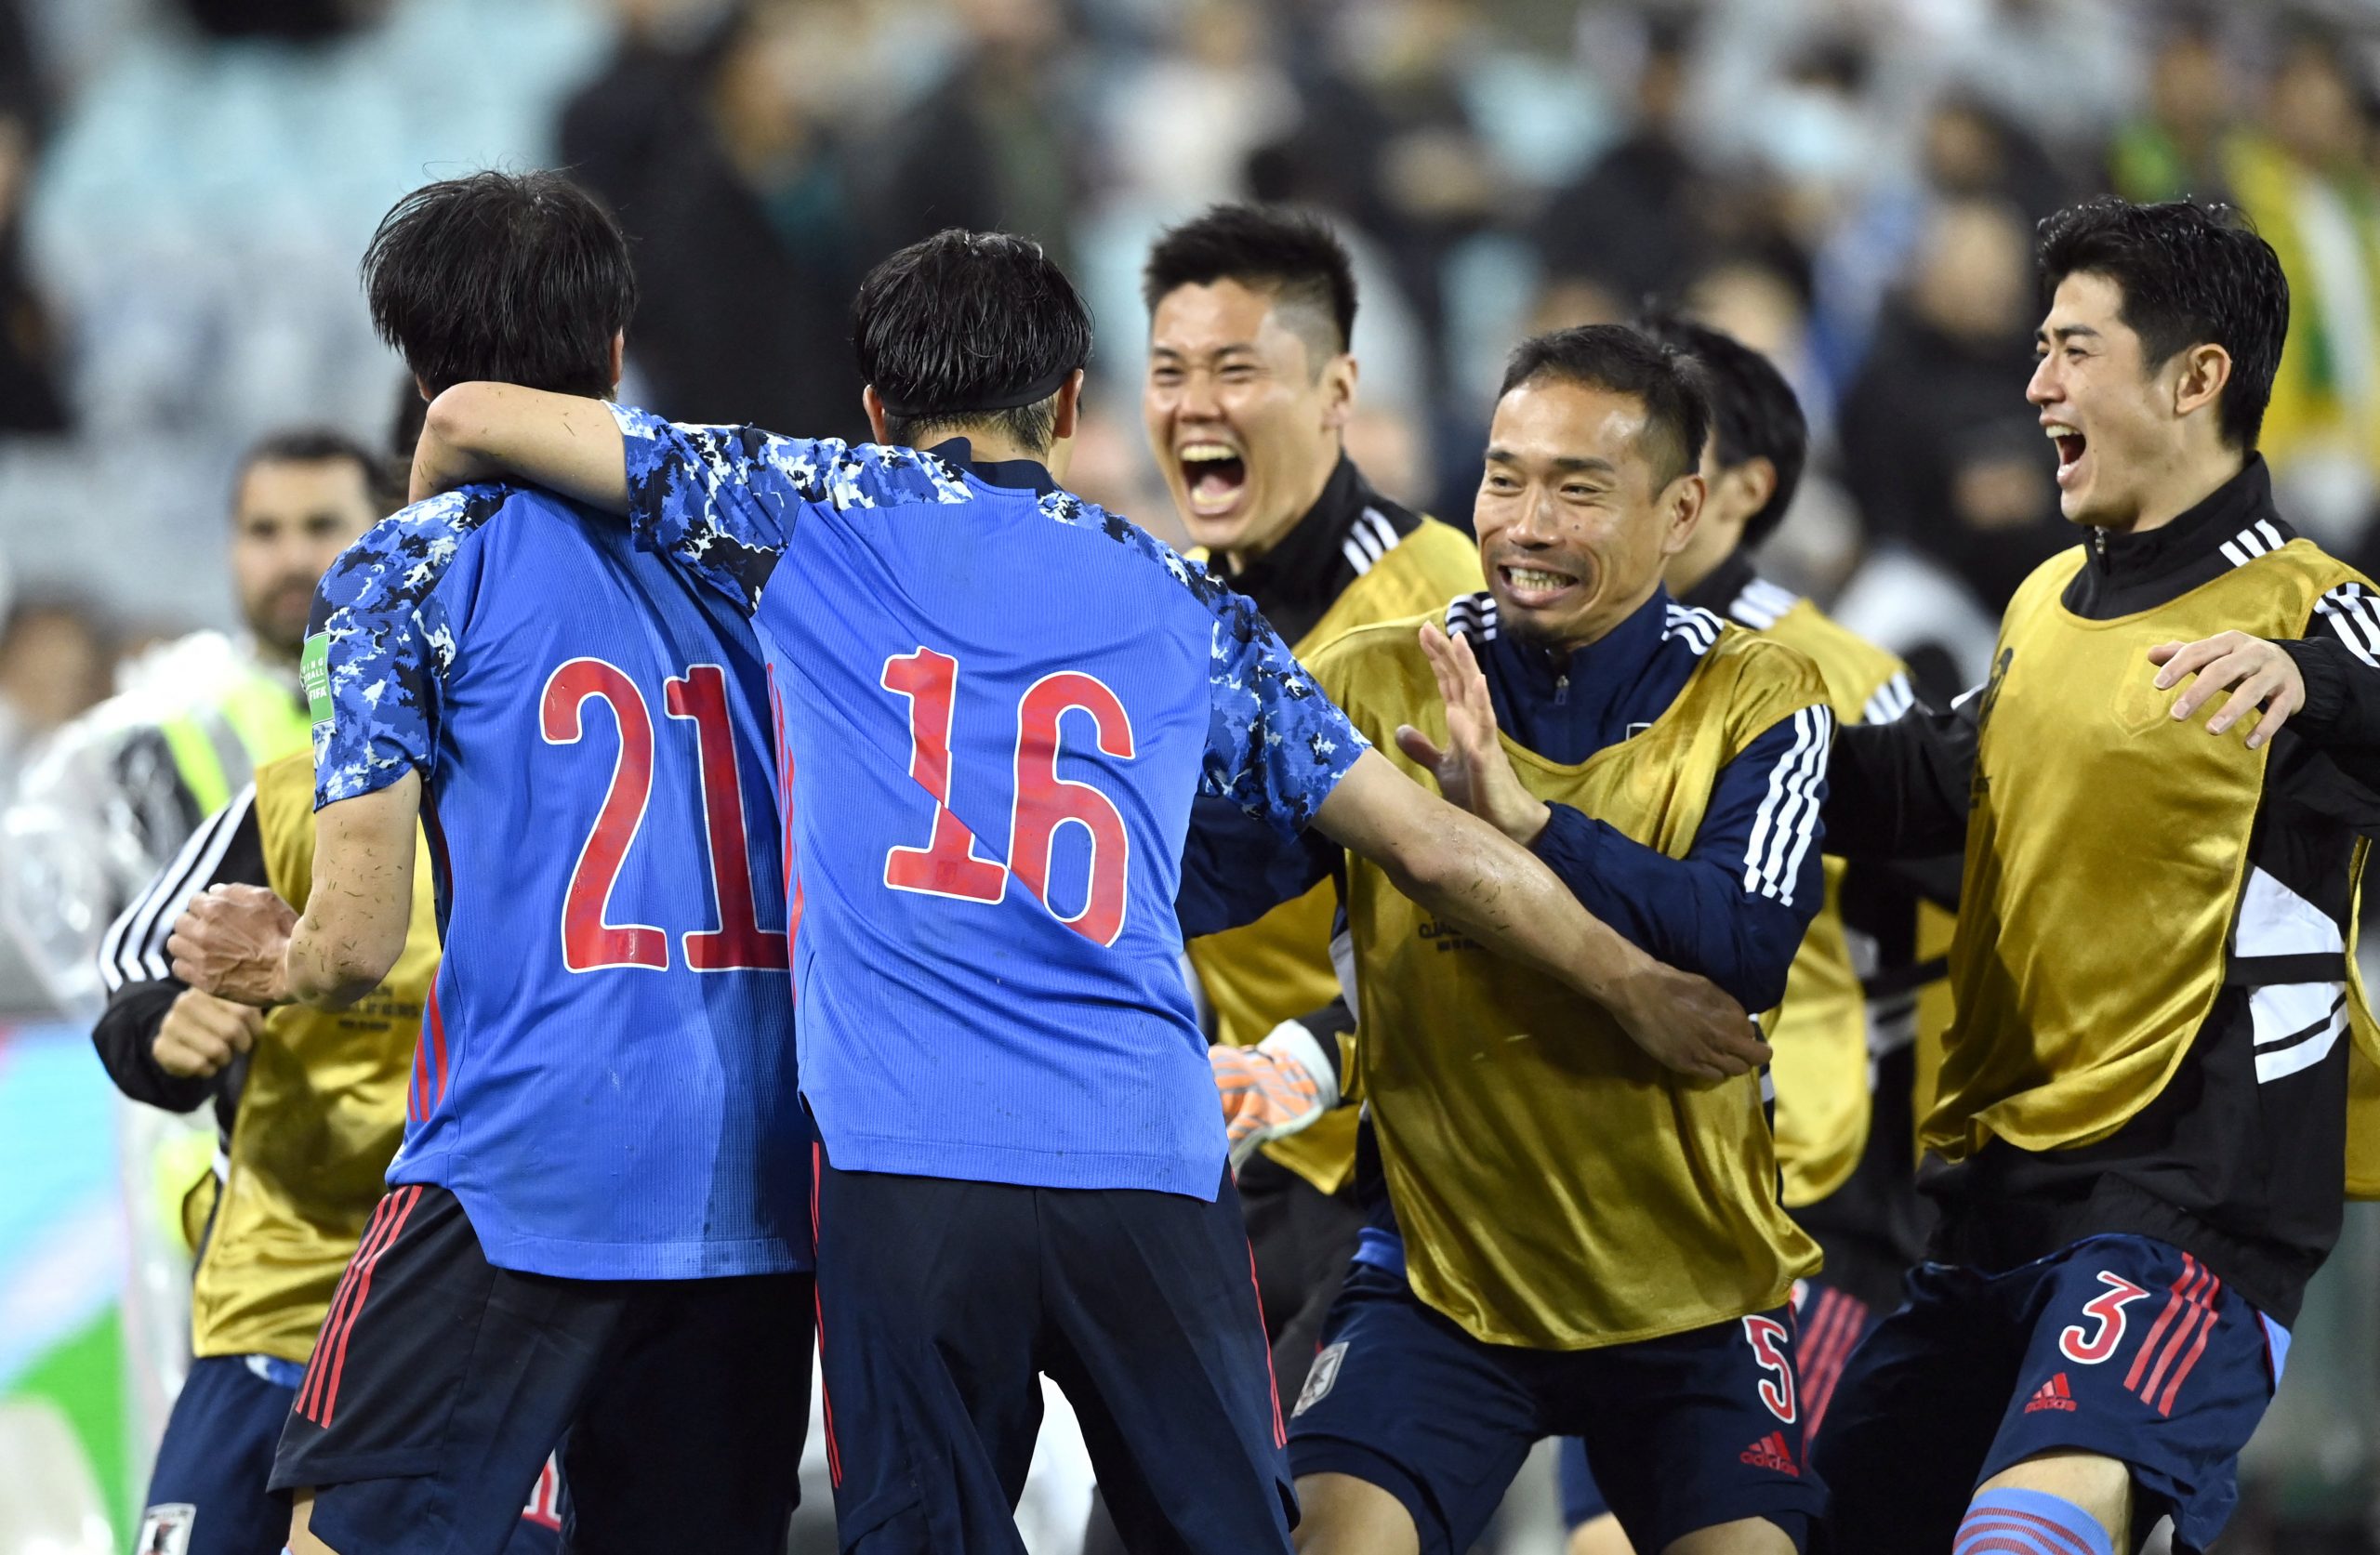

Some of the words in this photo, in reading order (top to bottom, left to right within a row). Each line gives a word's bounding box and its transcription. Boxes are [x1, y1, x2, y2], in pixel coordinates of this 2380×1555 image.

[309, 685, 327, 701] FIFA
[539, 656, 789, 973] 21
[879, 645, 1136, 948] 16
[2059, 1270, 2151, 1365] 3
[1741, 1314, 1797, 1425] 5
[2024, 1396, 2078, 1414] adidas
[1739, 1451, 1800, 1479] adidas
